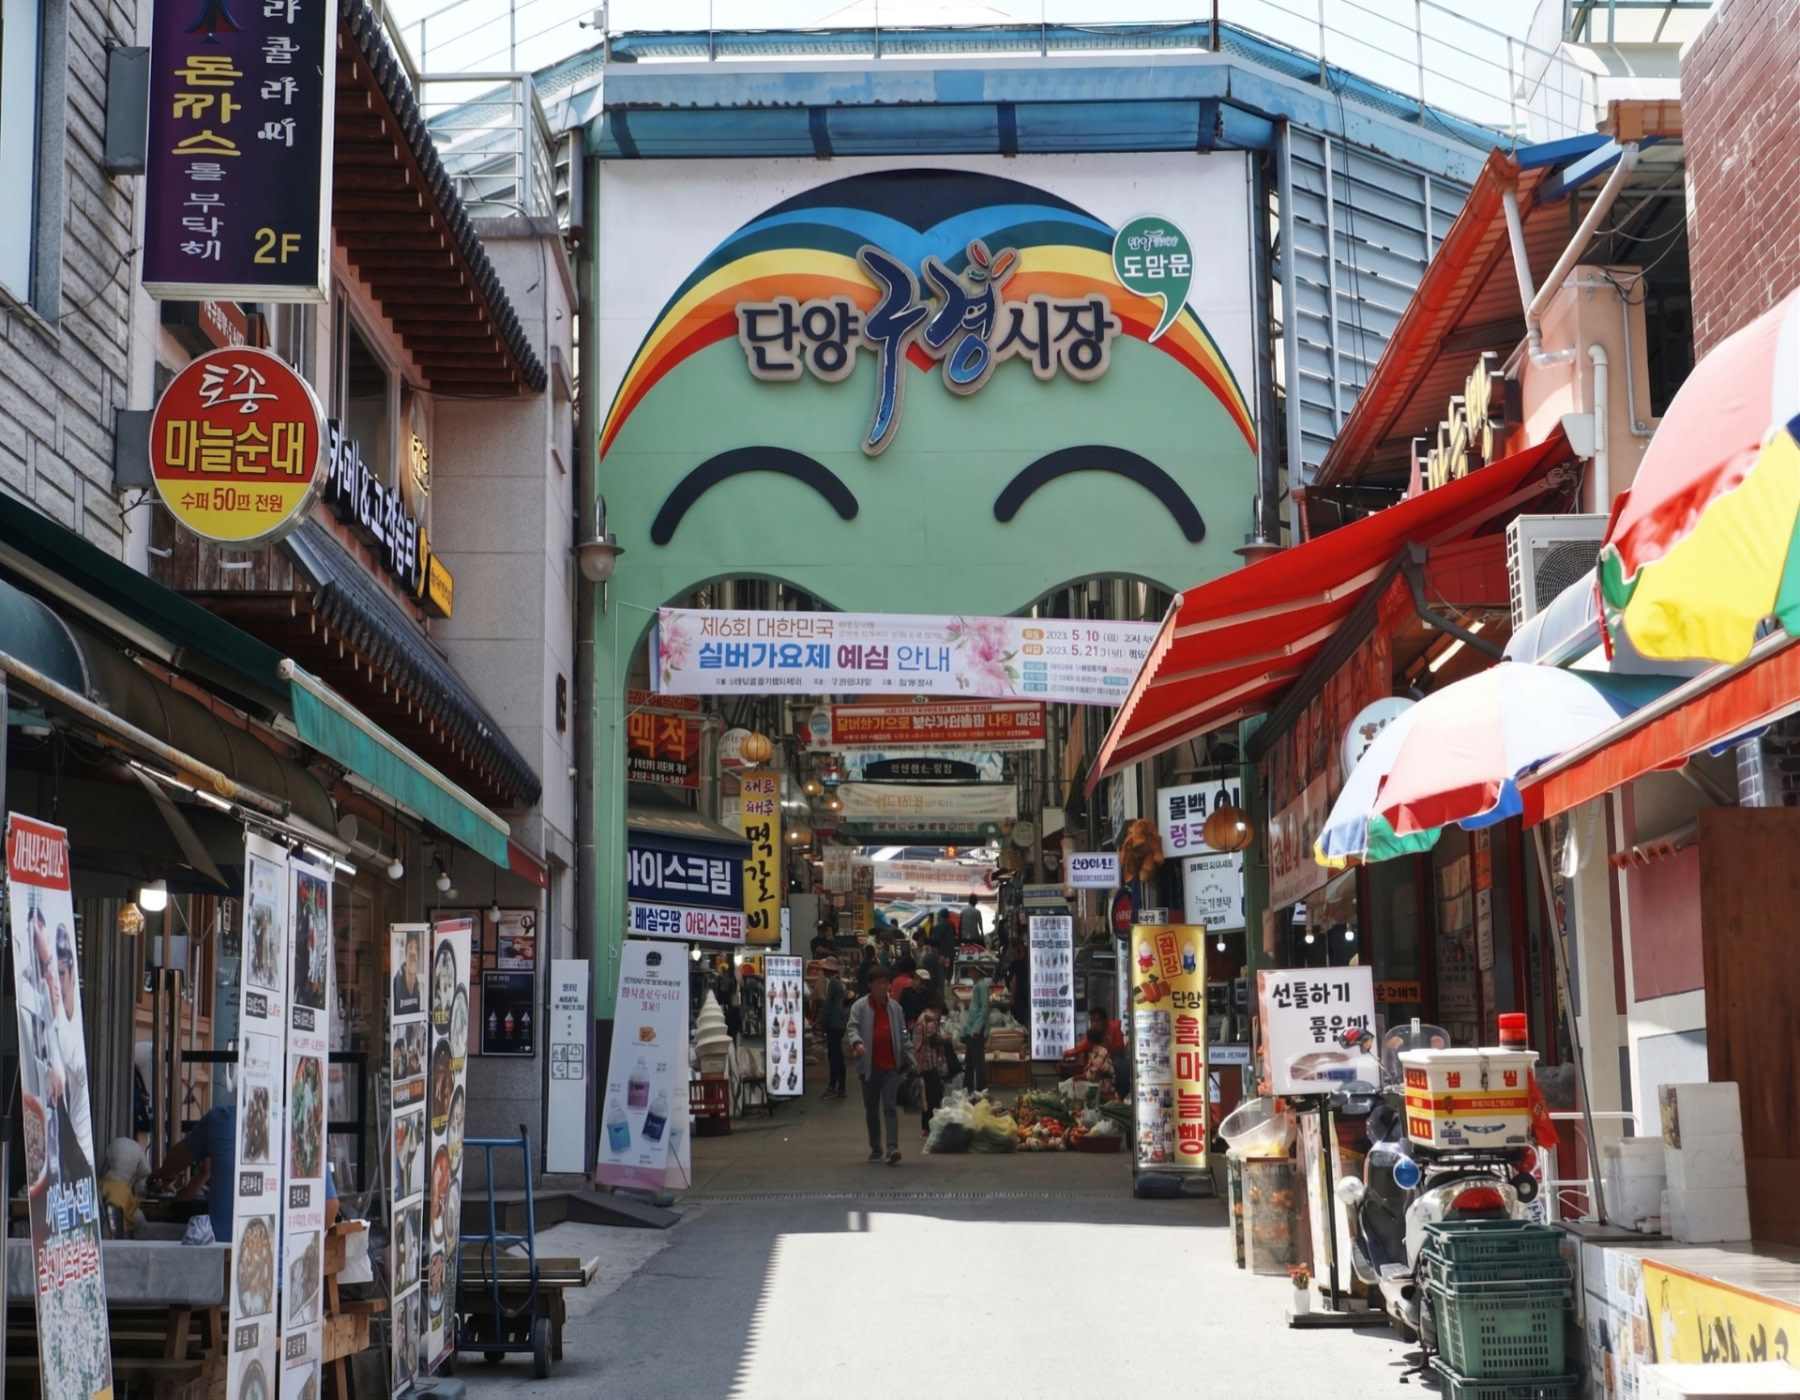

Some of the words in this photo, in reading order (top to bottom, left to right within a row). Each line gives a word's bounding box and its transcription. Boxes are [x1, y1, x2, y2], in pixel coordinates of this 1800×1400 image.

[253, 227, 301, 264] 2F
[198, 363, 279, 413] 토종
[165, 420, 306, 475] 마늘순대
[700, 617, 751, 637] 제6회
[757, 618, 834, 639] 대한민국
[699, 642, 831, 669] 실버가요제
[837, 644, 889, 670] 예심
[897, 646, 950, 672] 안내
[628, 850, 731, 895] 아이스크림
